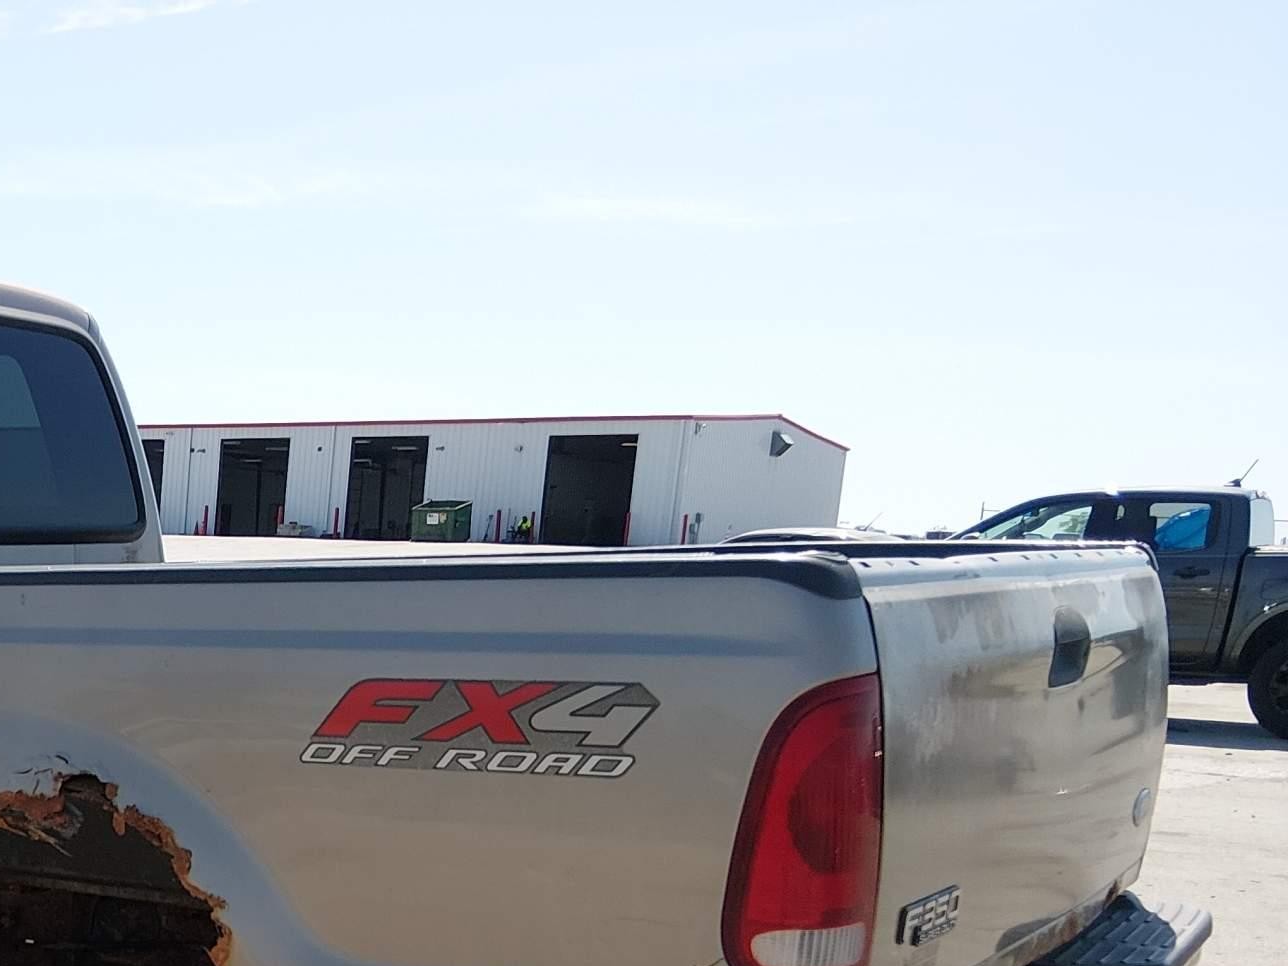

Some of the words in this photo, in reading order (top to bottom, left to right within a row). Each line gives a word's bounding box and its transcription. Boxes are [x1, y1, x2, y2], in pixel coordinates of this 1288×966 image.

[312, 678, 660, 748] FX4
[299, 742, 421, 767] OFF
[433, 748, 636, 778] ROAD
